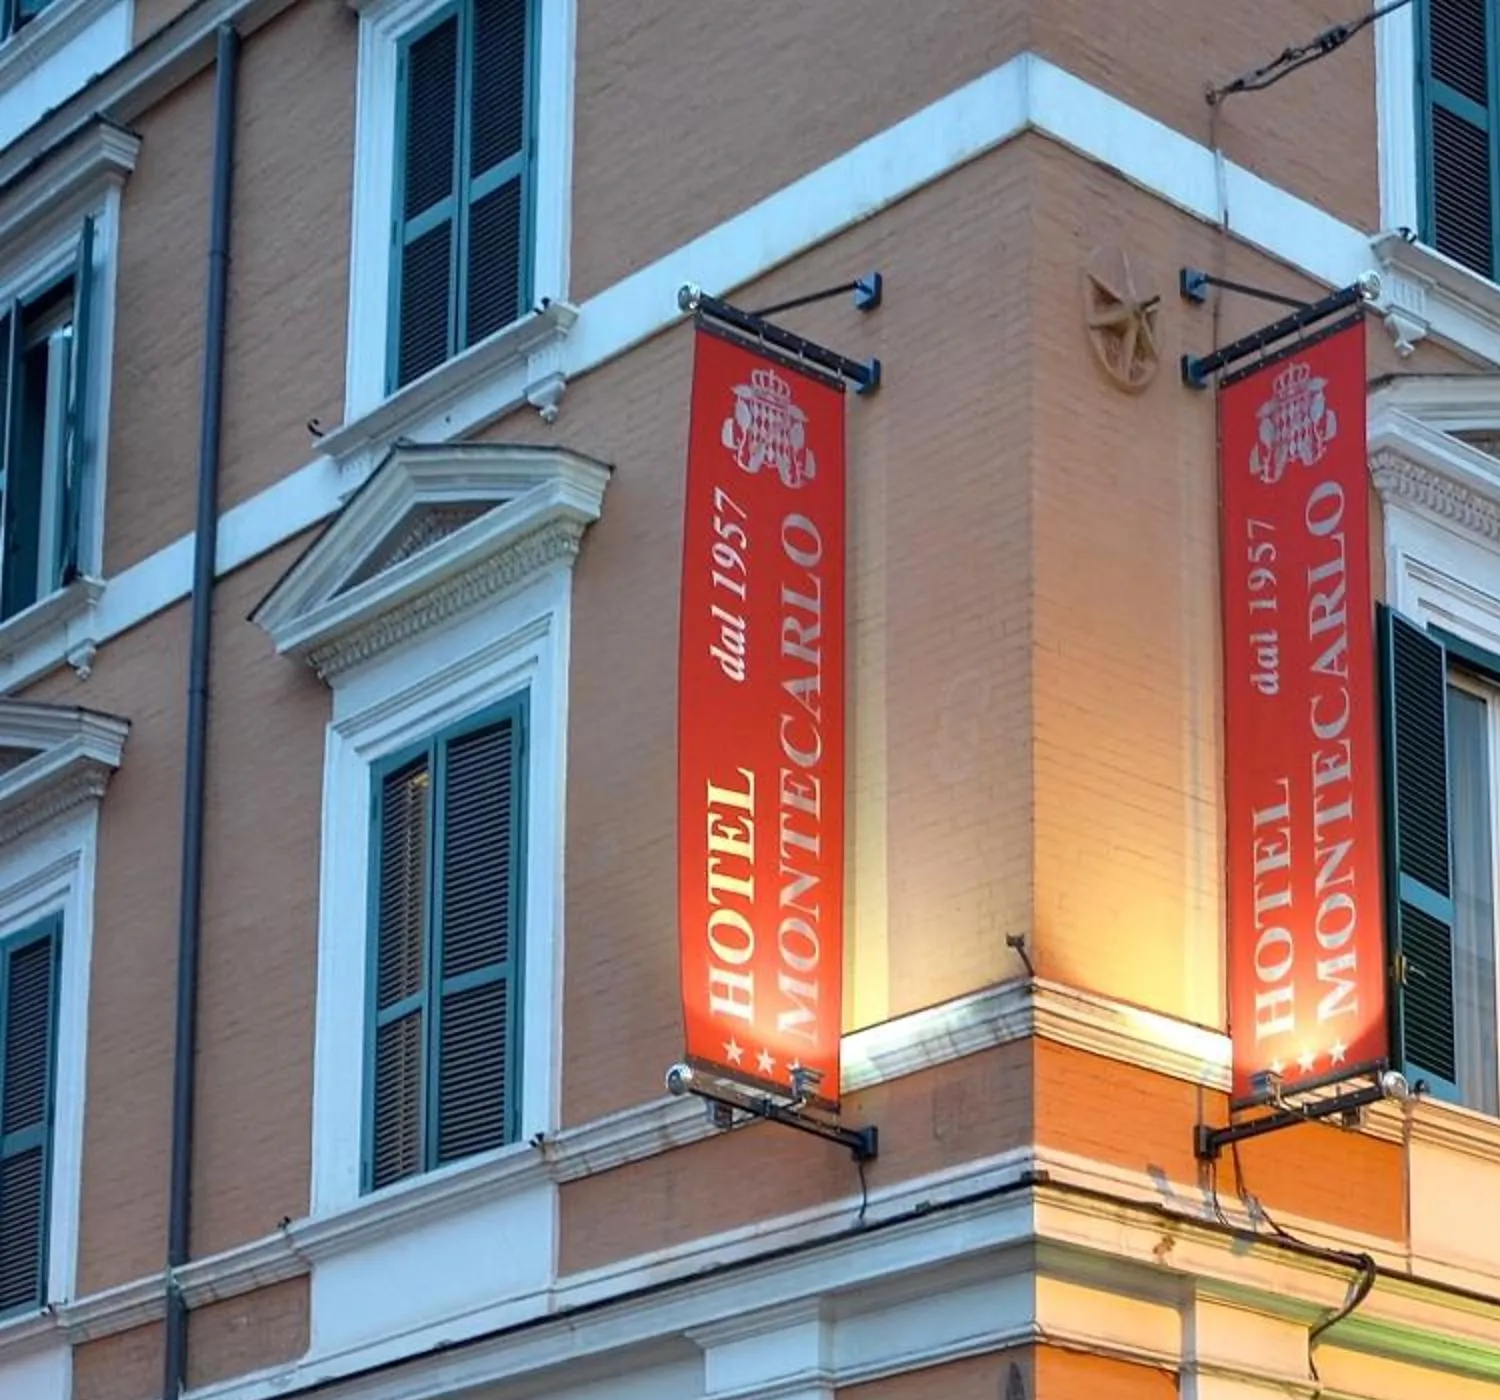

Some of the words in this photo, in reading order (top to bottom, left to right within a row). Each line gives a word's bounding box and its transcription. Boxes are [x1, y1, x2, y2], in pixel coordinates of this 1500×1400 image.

[711, 485, 748, 603] 1957
[1247, 518, 1278, 615] 1957
[708, 604, 746, 682] dal
[1249, 628, 1280, 695] dal
[776, 513, 823, 1047] MONTECARLO
[1305, 481, 1359, 1025] MONTECARLO
[707, 767, 756, 1027] HOTEL
[1252, 777, 1296, 1043] HOTEL
